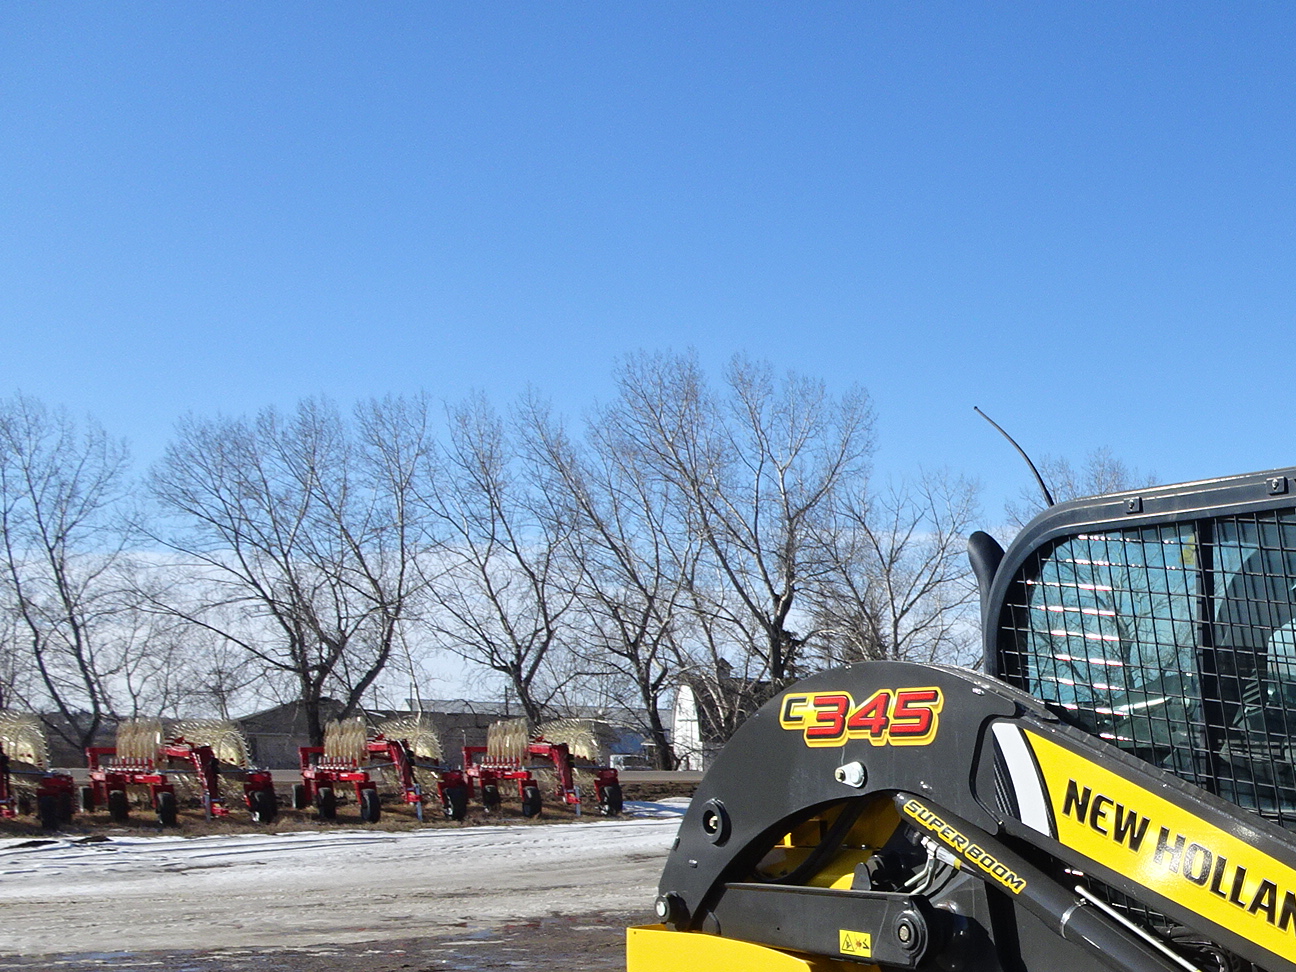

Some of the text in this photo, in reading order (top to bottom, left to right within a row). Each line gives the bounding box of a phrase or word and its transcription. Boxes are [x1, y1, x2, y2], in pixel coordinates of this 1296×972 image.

[781, 687, 944, 746] C345
[903, 799, 1027, 894] SUPER BOOM
[1062, 779, 1150, 852] NEW
